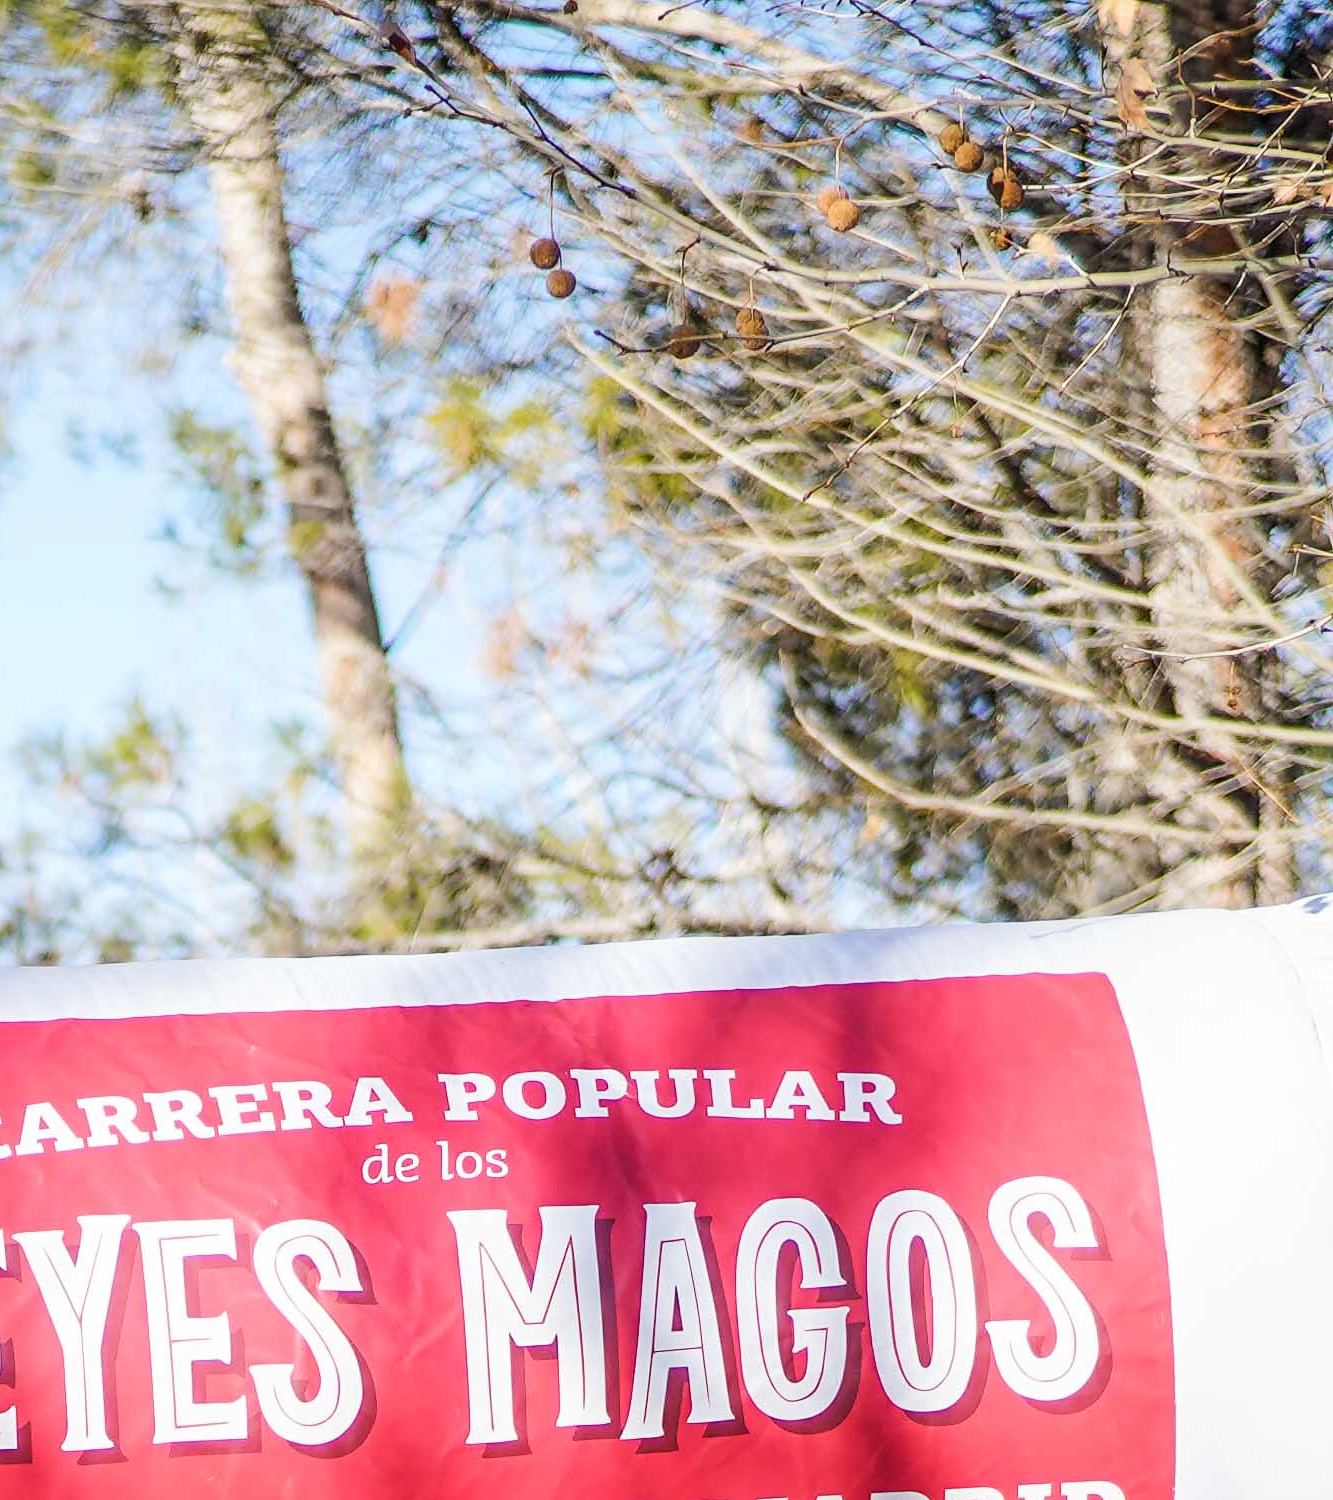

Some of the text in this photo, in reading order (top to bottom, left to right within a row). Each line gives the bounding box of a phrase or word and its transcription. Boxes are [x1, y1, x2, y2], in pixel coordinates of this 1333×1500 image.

[438, 1069, 903, 1124] POPULAR
[362, 1141, 510, 1185] de los
[446, 1176, 1103, 1445] MAGOS
